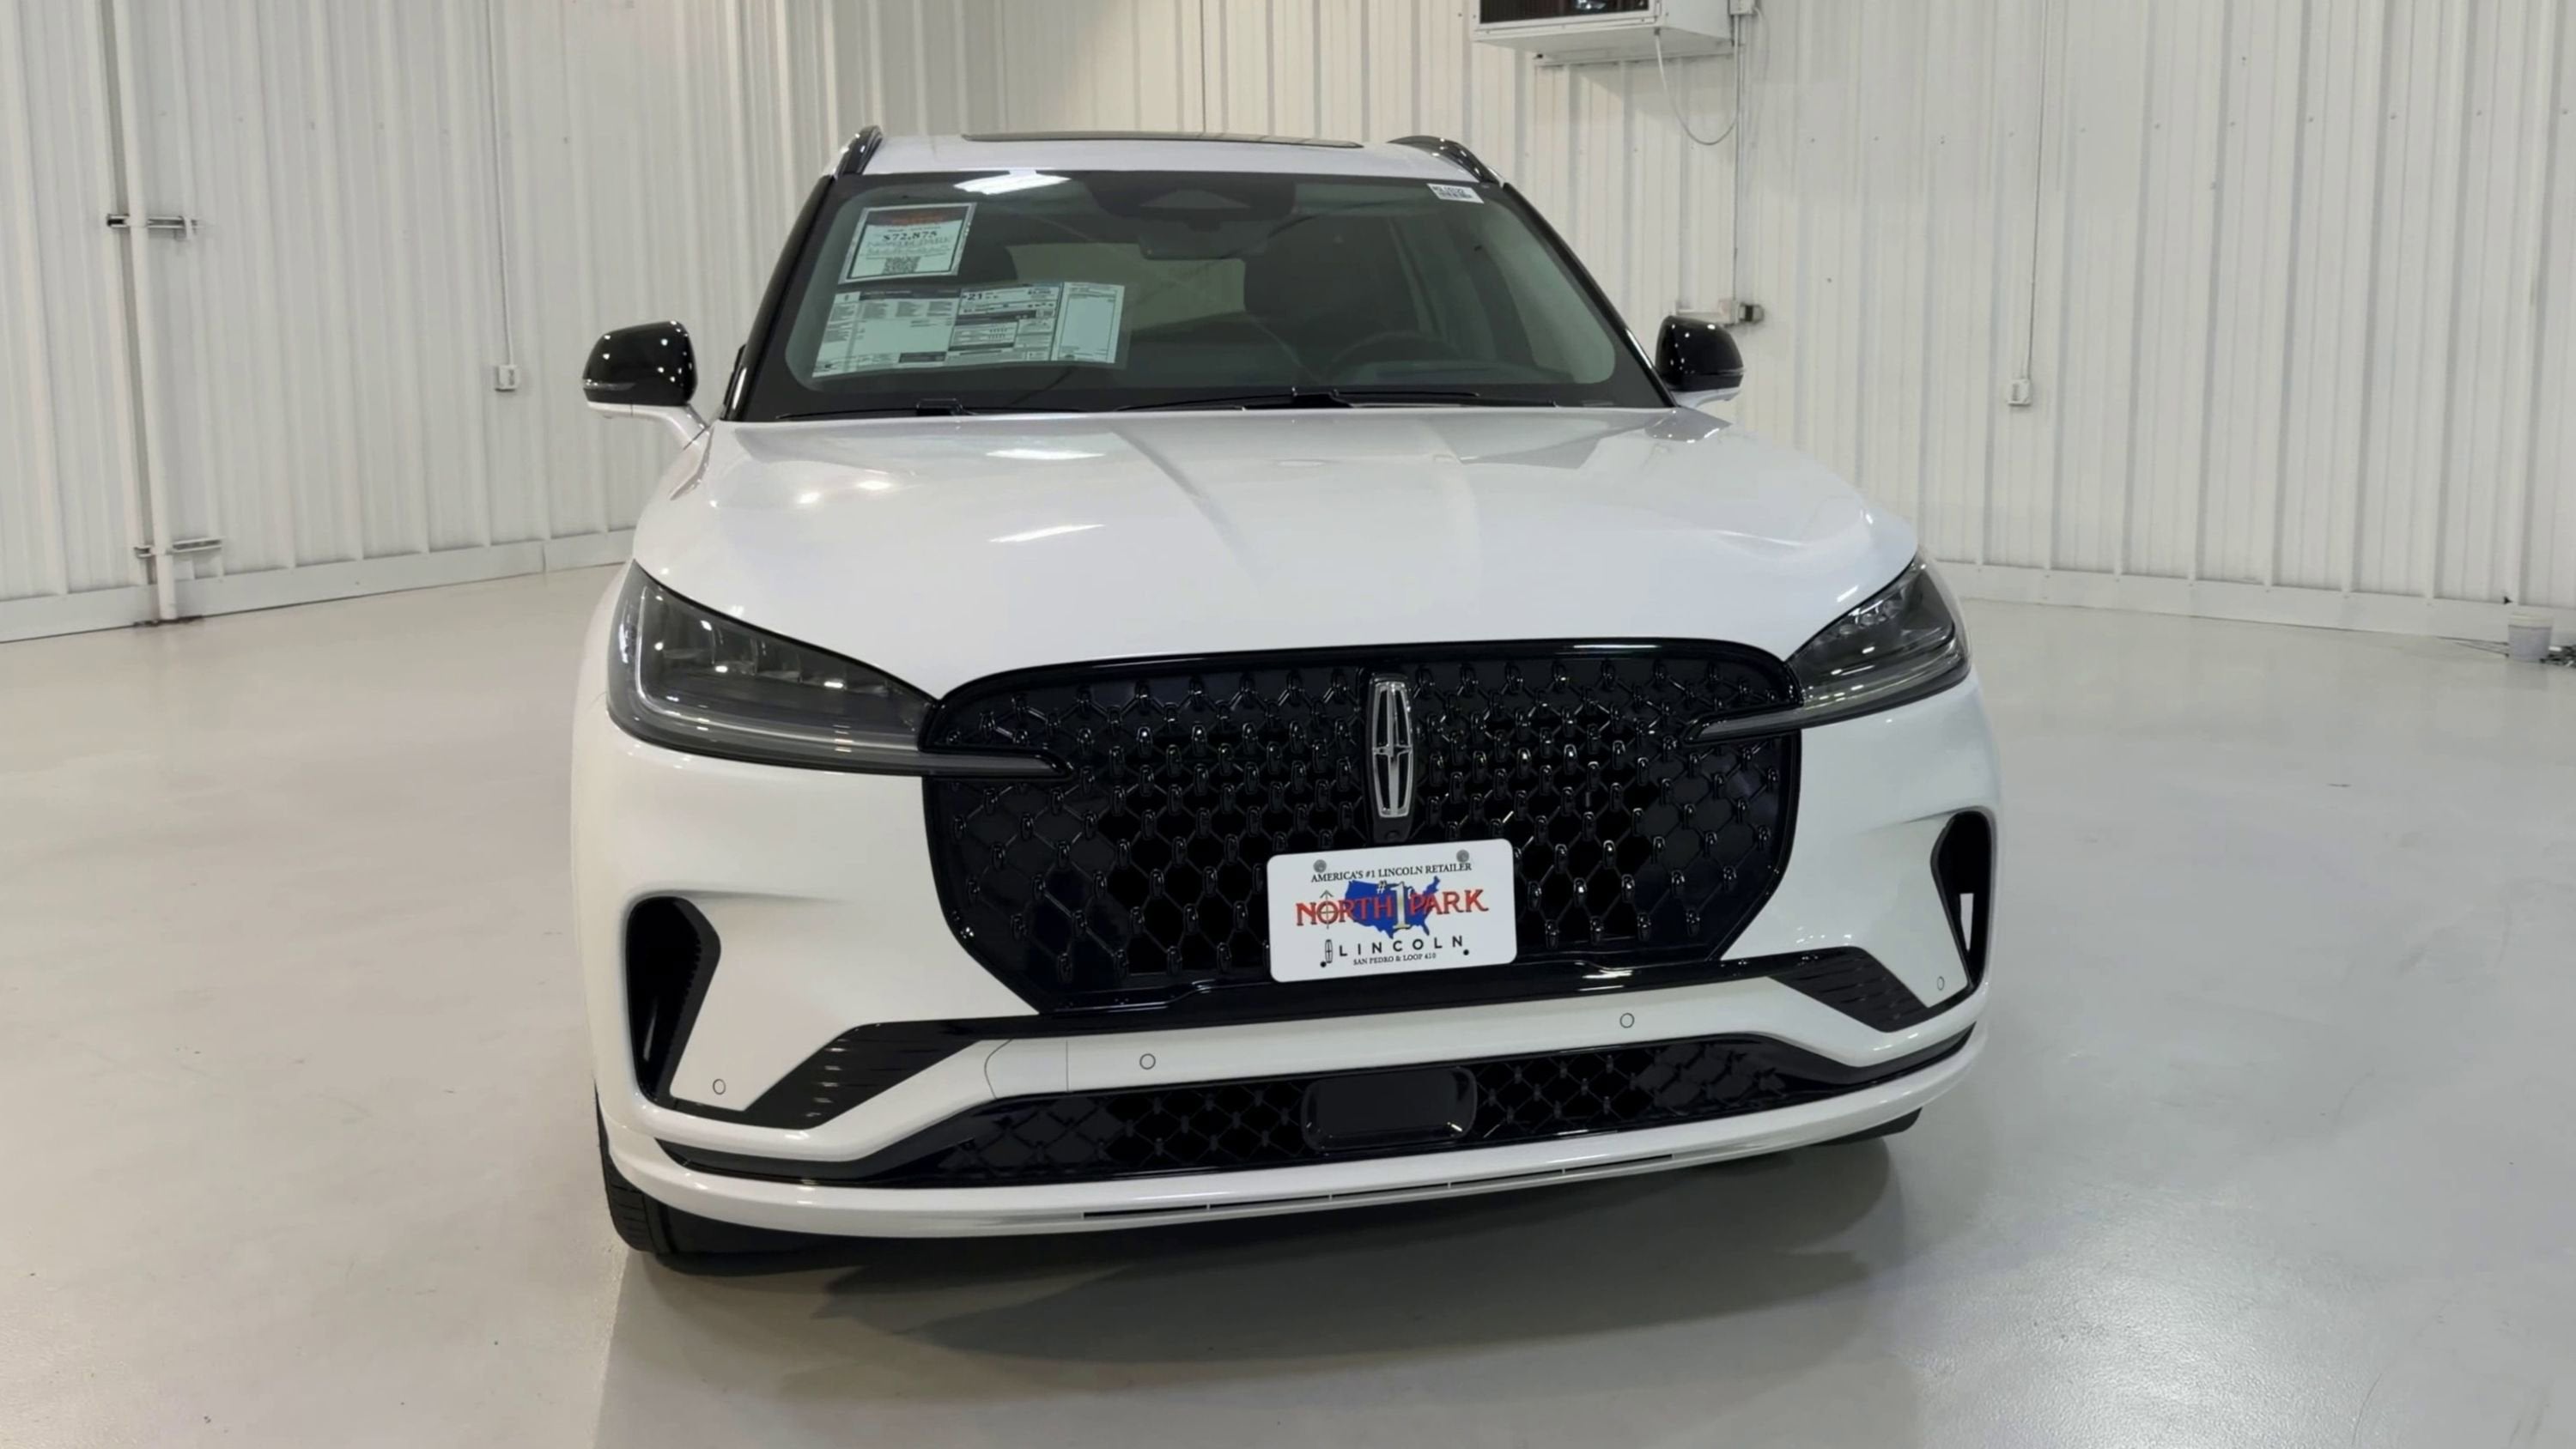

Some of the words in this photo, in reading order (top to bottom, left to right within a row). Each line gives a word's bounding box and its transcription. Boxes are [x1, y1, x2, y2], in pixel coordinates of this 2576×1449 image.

[1311, 870, 1363, 882] AMERICA'S
[1365, 870, 1376, 878] #1
[1378, 865, 1423, 877] LINCOLN
[1425, 863, 1472, 874] RETAILER
[1296, 894, 1394, 926] NORTH
[1410, 889, 1489, 916] PARK
[1340, 936, 1462, 956] LINCOLN
[1370, 955, 1394, 964] PEDRO
[1403, 953, 1423, 961] LOOP
